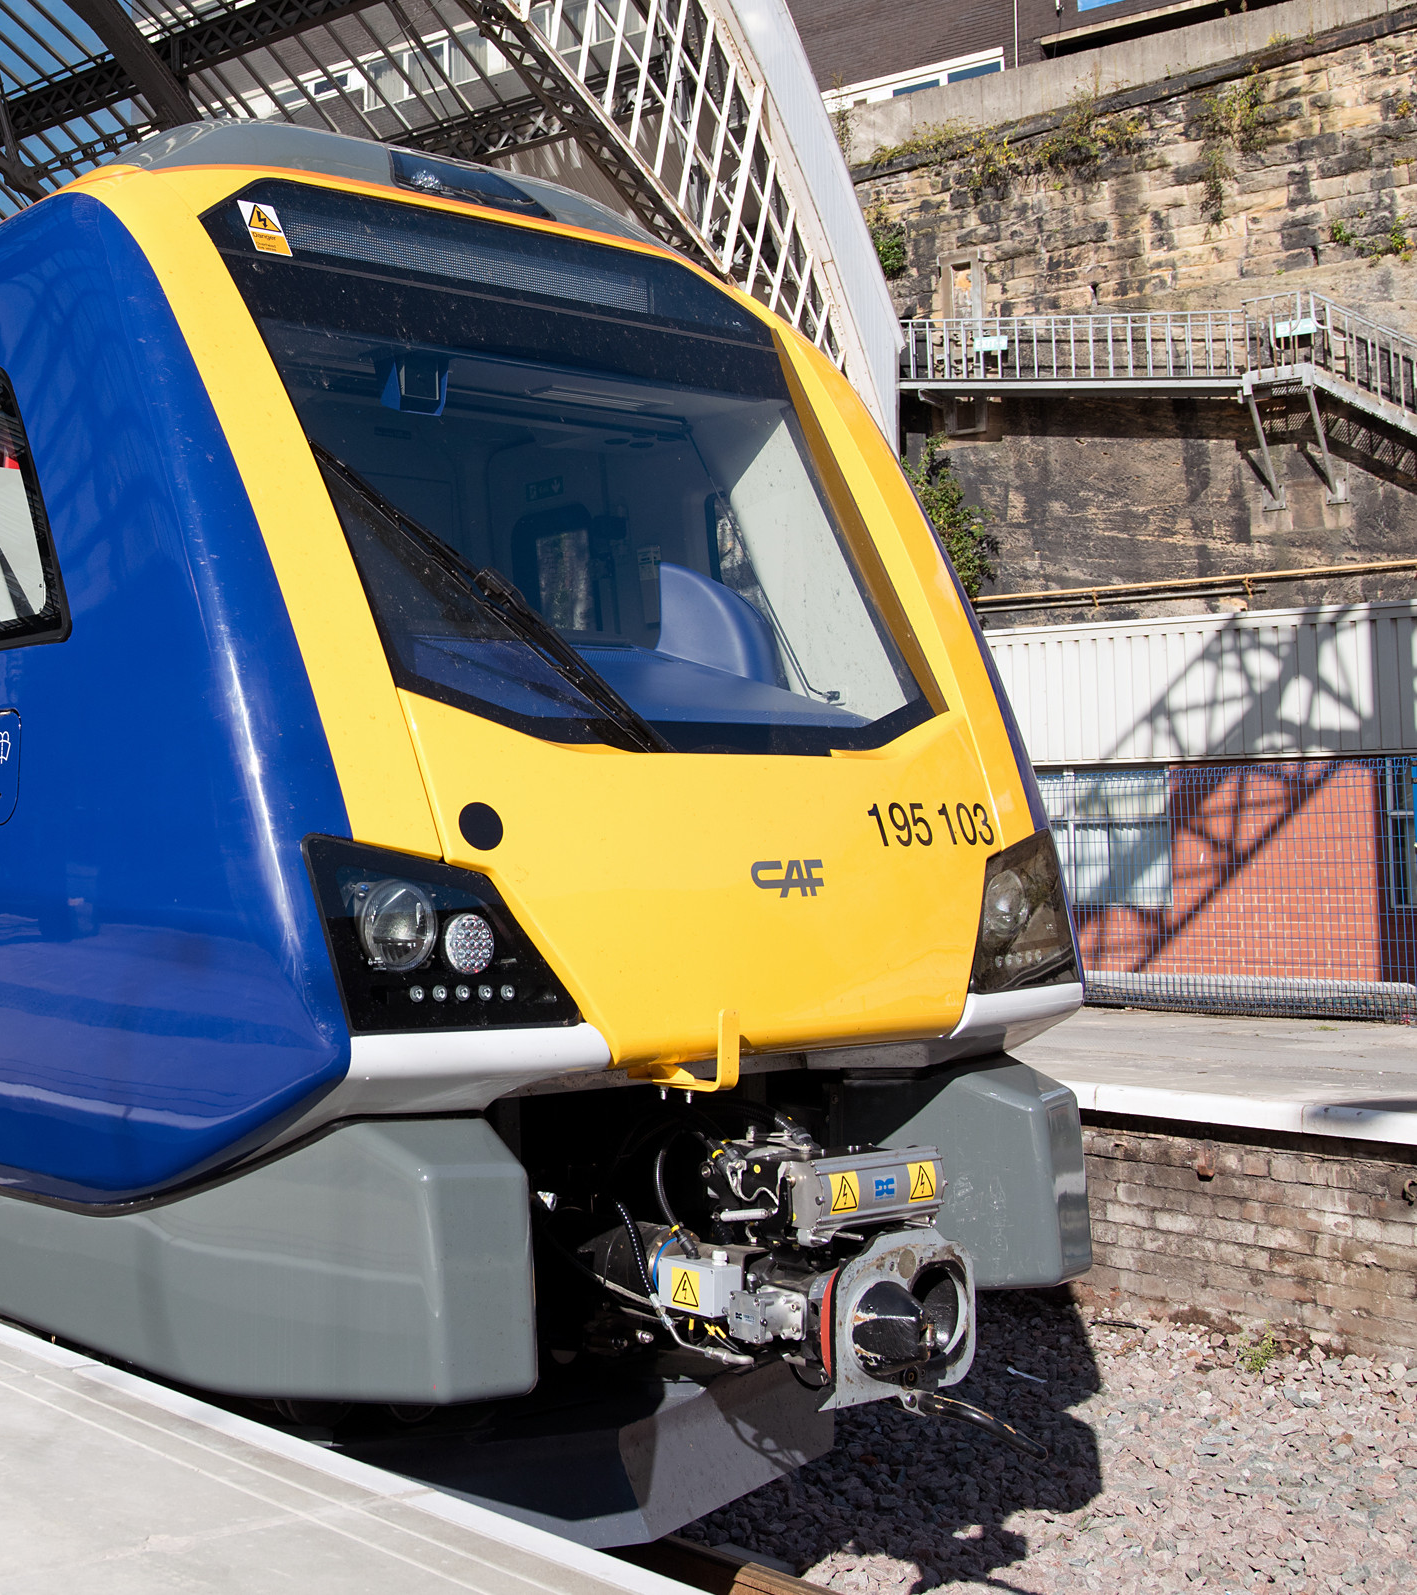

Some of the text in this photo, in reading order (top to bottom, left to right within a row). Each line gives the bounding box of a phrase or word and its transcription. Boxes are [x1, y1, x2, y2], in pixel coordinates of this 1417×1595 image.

[252, 232, 276, 241] Danger
[975, 339, 996, 349] EXIT
[867, 802, 995, 847] 195 103
[750, 859, 825, 898] CAF
